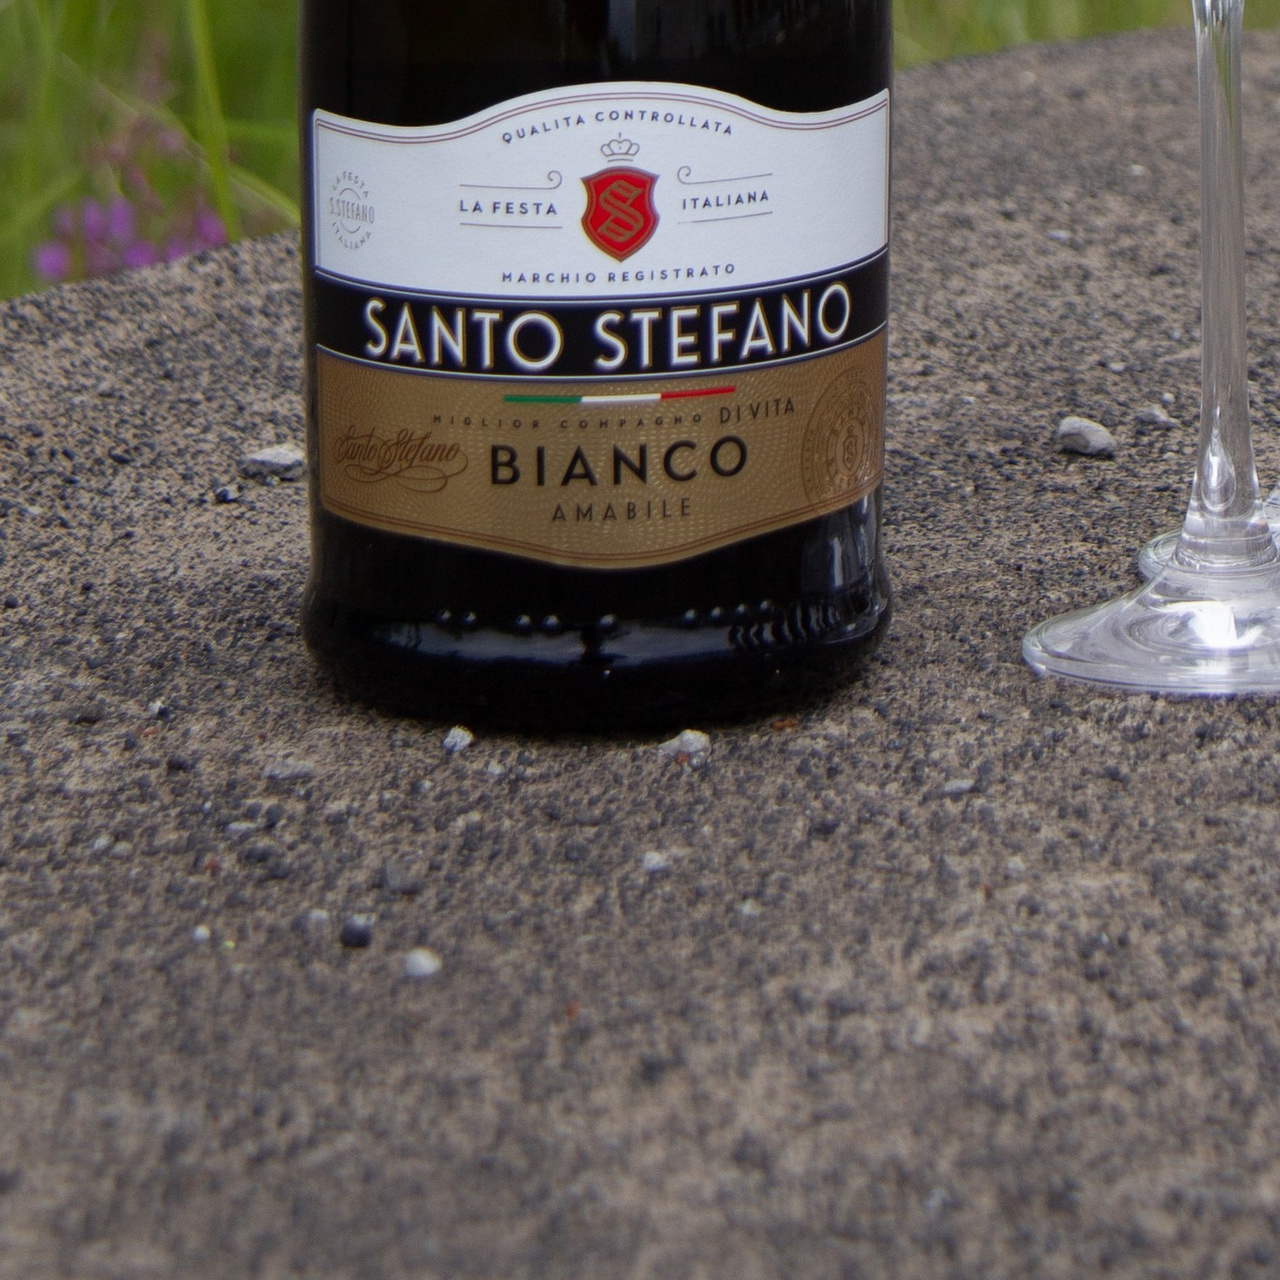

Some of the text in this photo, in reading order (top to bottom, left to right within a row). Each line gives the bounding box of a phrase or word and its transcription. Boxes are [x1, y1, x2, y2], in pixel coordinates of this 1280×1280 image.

[502, 109, 733, 144] QUALITA CONTROLLATA
[459, 190, 770, 216] LA FESTA ITALIANA
[502, 263, 735, 284] MARCHIO REGISTRATO
[365, 280, 852, 371] SANTO STEFANO
[433, 414, 540, 429] MIGLIOR
[719, 405, 741, 424] DI
[750, 396, 795, 420] VITA
[490, 435, 748, 487] BIANCO
[551, 497, 691, 522] AMABILE
